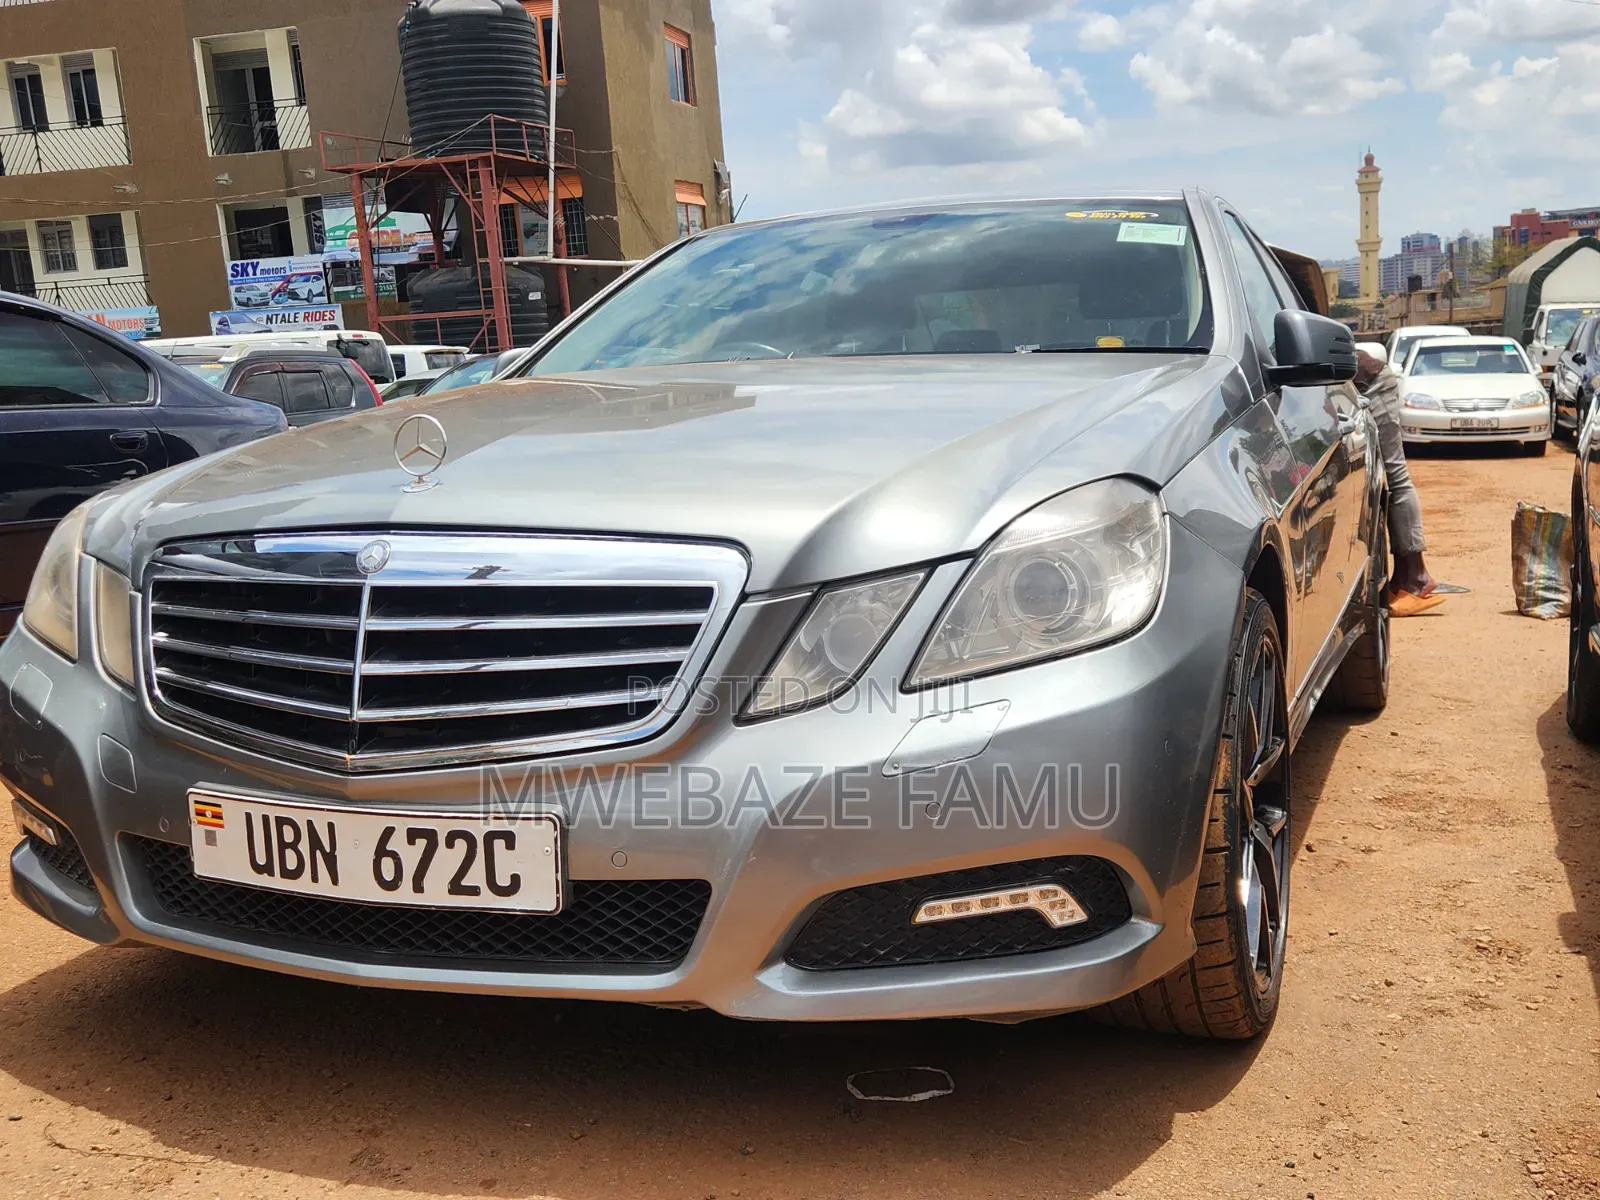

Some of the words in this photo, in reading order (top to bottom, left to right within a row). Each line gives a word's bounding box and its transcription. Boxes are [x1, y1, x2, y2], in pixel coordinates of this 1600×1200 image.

[230, 261, 260, 278] SKY
[260, 265, 287, 276] motors
[108, 318, 144, 330] MOTORS
[265, 312, 300, 325] NTALE
[303, 310, 336, 322] RIDES
[245, 811, 339, 886] UBN
[372, 826, 521, 897] 672C
